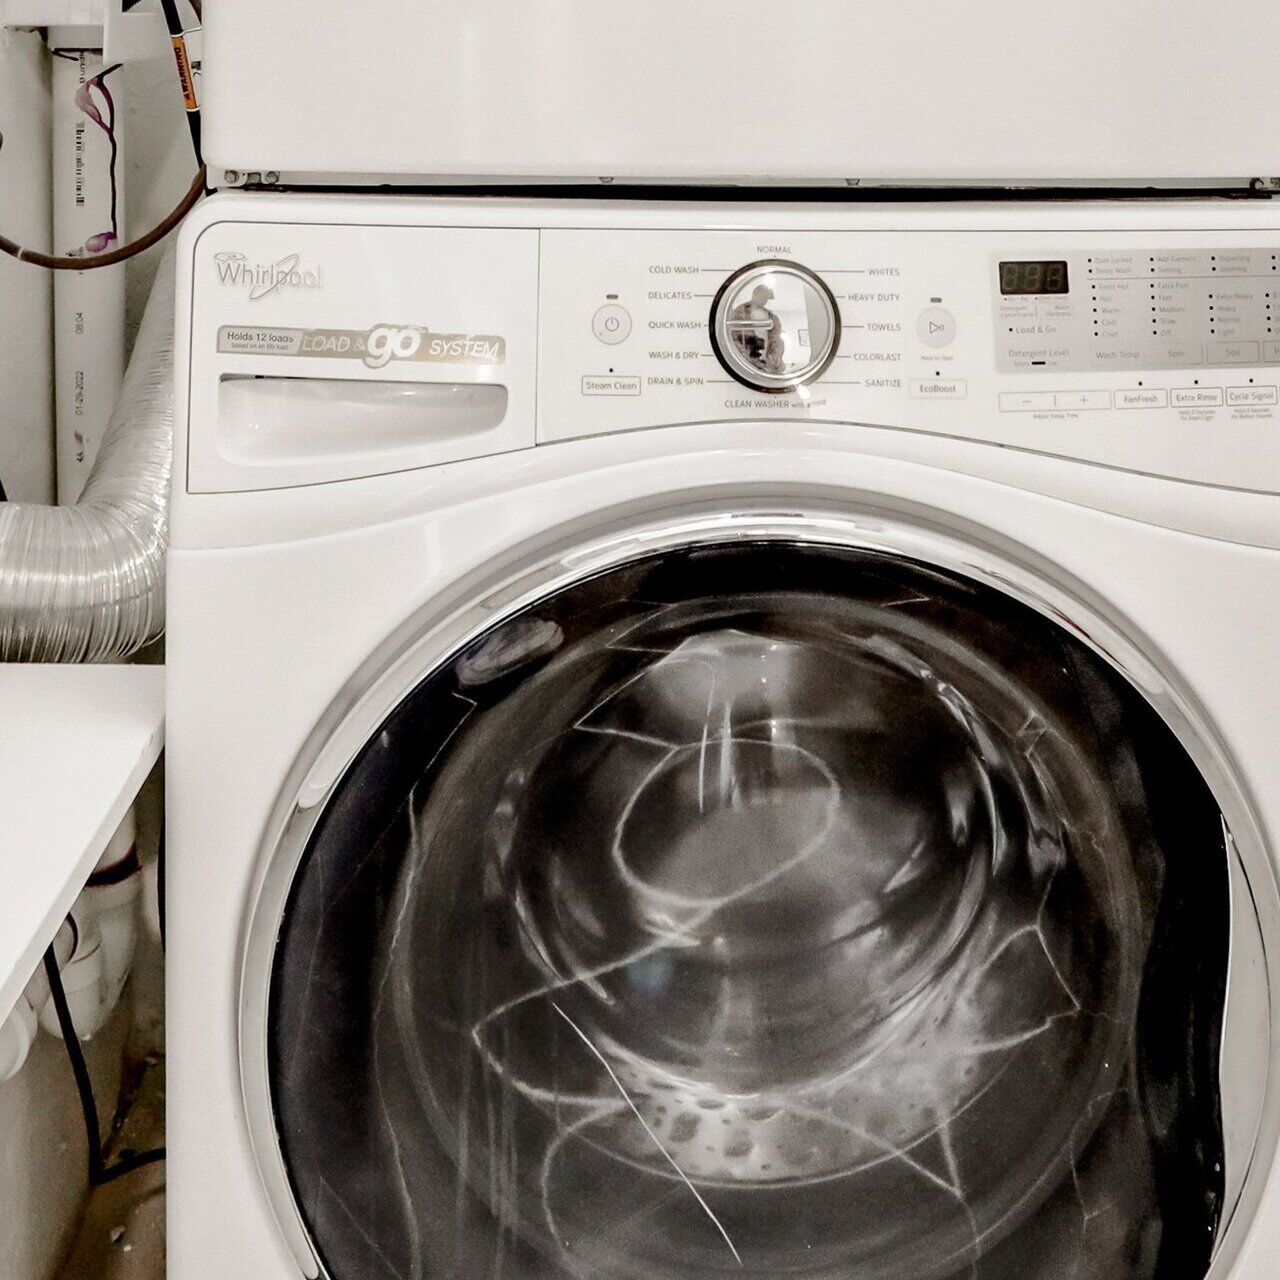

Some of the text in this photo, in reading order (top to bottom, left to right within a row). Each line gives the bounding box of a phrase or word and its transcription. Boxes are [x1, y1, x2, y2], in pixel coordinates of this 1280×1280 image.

[174, 46, 189, 93] WARNING
[757, 246, 792, 254] NORMAL
[648, 266, 700, 274] COLD WASH
[868, 268, 900, 276] WHITES
[217, 262, 324, 294] Whirlpool
[648, 292, 692, 300] DELICATES
[848, 294, 900, 302] HEAVY DUTY
[648, 321, 701, 330] QUICK WASH
[868, 323, 902, 332] TOWELS
[1016, 325, 1057, 334] Load & Go
[227, 332, 254, 341] Holds
[256, 333, 267, 342] 12
[302, 327, 500, 368] LOAD & go SYSTEM
[854, 353, 902, 362] COLORLAST
[1008, 350, 1047, 359] Detergent
[1096, 352, 1118, 360] Wash
[586, 382, 637, 390] Steam Clean
[647, 378, 704, 386] DRAIN & SPIN
[864, 380, 902, 388] SANITIZE
[920, 384, 956, 394] EcoBoost
[1124, 394, 1158, 404] FanFresh
[1176, 394, 1218, 402] Extra Rinse
[1230, 392, 1274, 402] Cycle Signal
[724, 400, 752, 408] CLEAN
[754, 400, 790, 408] WASHER
